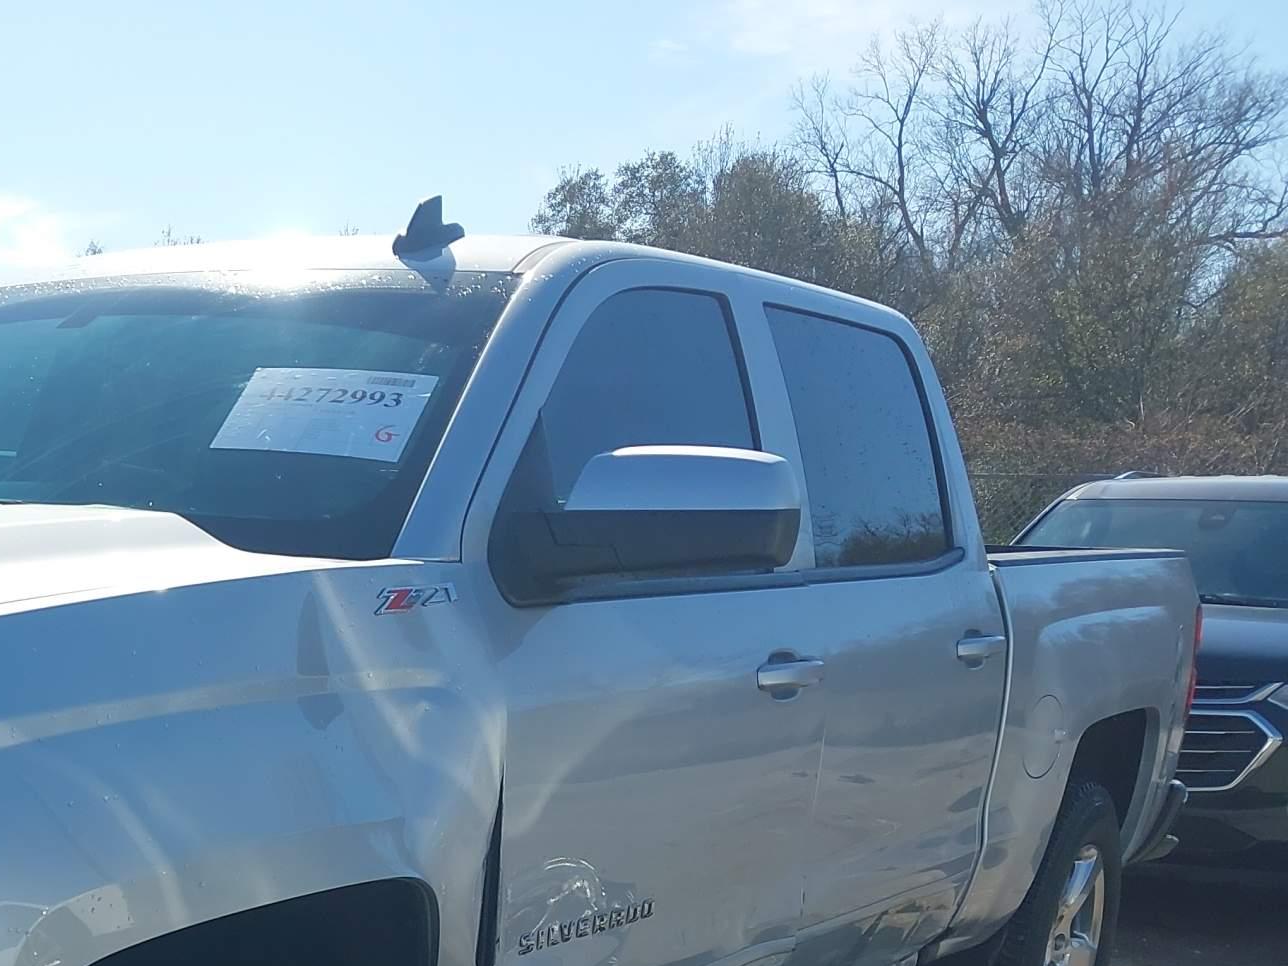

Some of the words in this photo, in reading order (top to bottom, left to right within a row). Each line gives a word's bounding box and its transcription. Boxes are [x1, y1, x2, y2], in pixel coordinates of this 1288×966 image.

[258, 386, 404, 408] 44272993
[373, 582, 457, 617] Z71
[518, 898, 656, 956] SILVERADO
